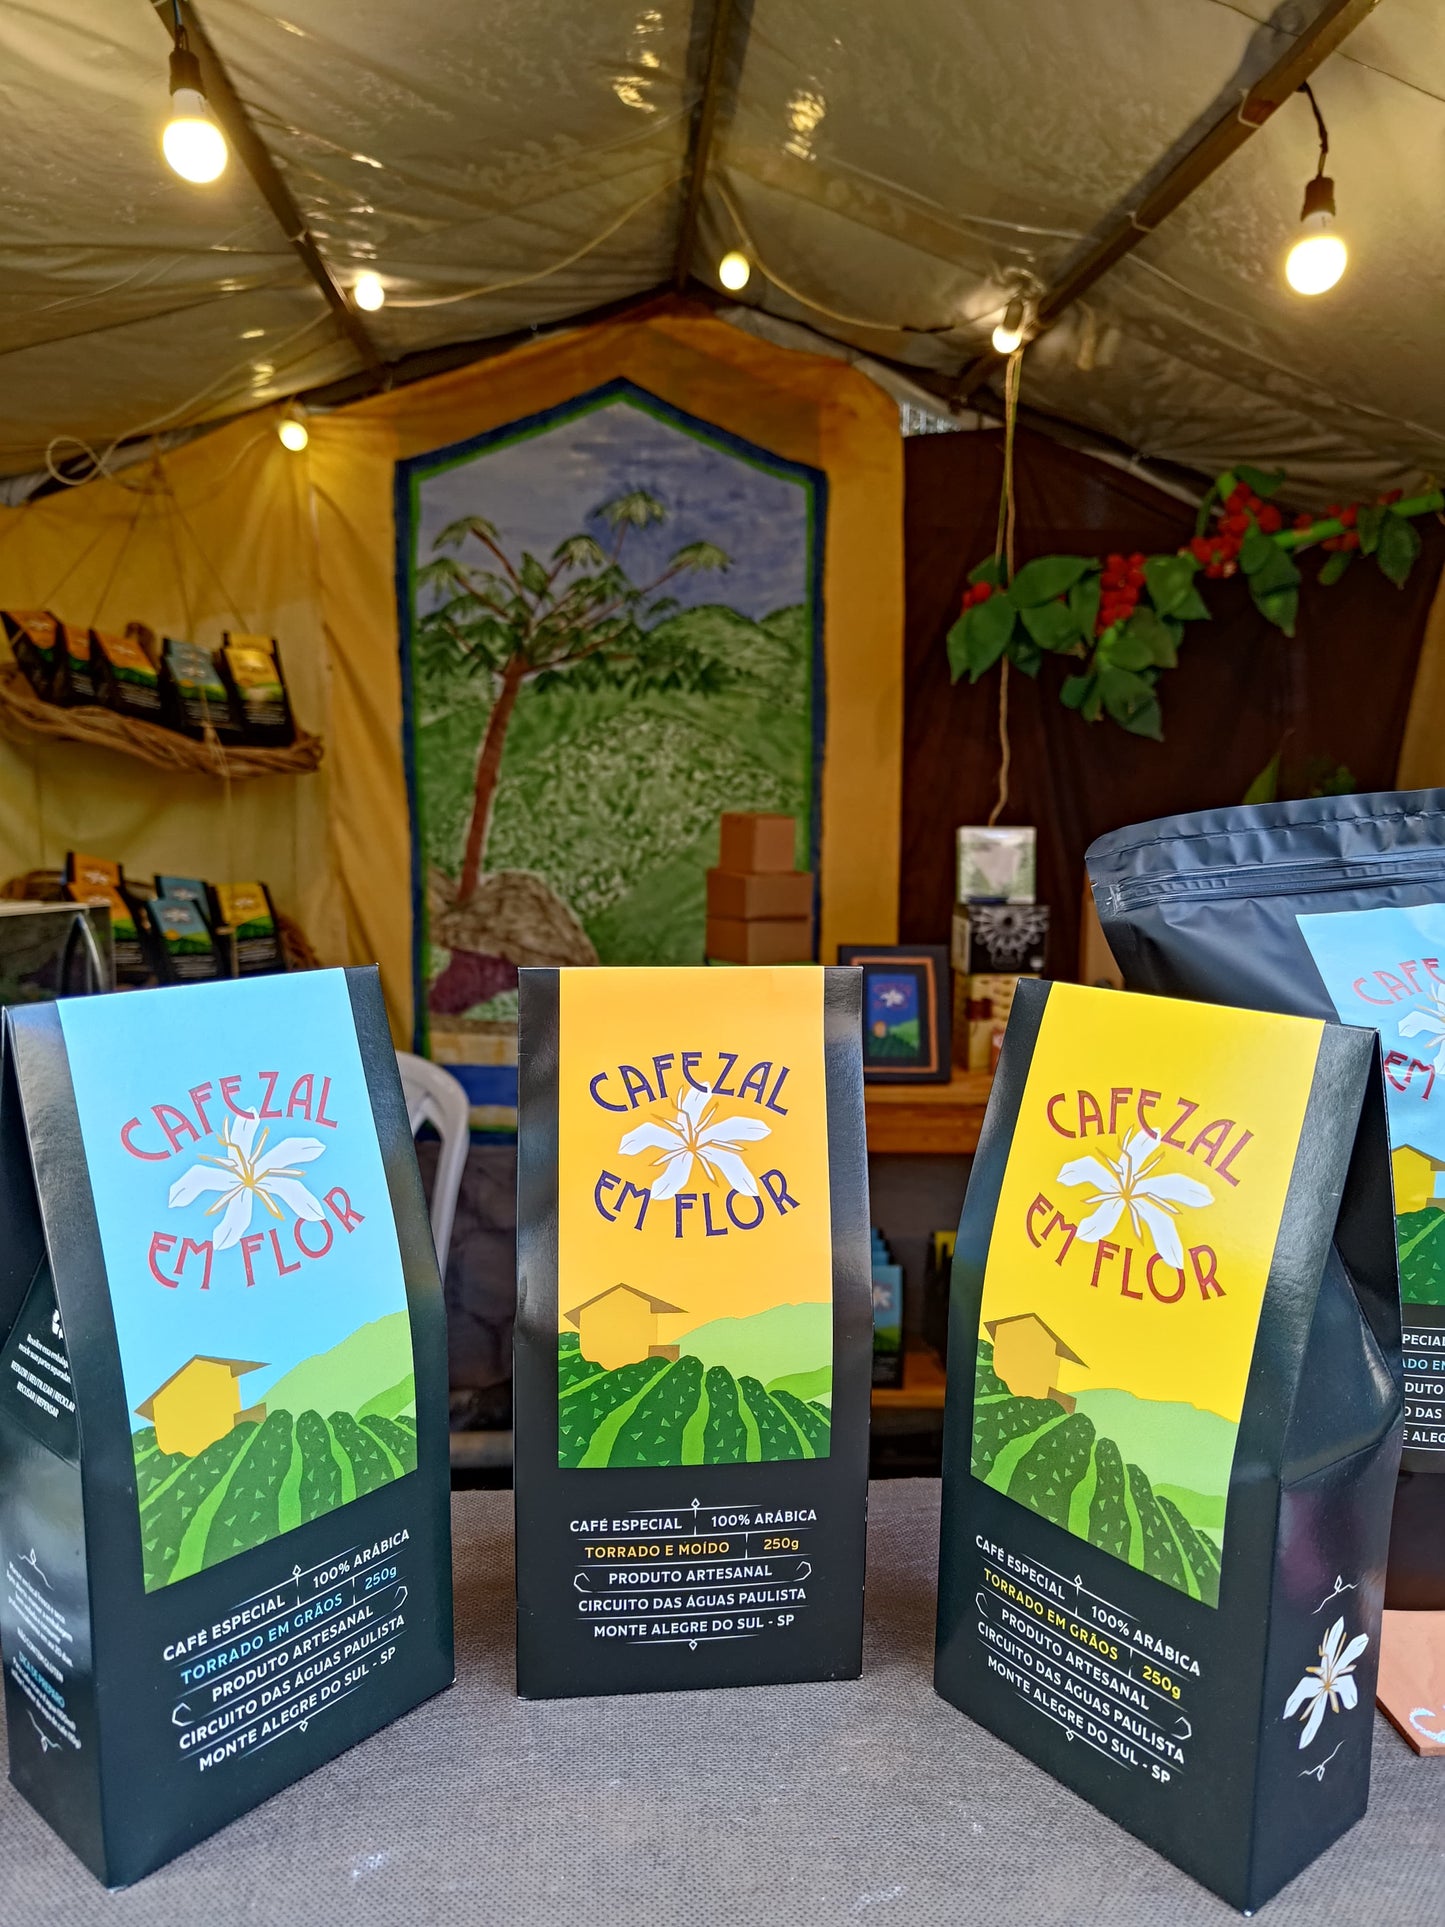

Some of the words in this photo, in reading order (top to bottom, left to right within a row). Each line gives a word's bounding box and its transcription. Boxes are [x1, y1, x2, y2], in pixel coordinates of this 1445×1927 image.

[589, 1051, 790, 1116] CAFEZAL
[1384, 1049, 1436, 1101] EM
[120, 1071, 338, 1162] CAFEZAL
[1047, 1087, 1254, 1187] CAFEZAL
[594, 1169, 651, 1231] EM
[675, 1168, 800, 1238] FLOR
[148, 1231, 213, 1290] EM
[240, 1186, 365, 1288] FLOR
[1026, 1192, 1078, 1266] EM
[1090, 1239, 1227, 1304] FLOR
[1416, 1407, 1442, 1419] DAS
[570, 1518, 608, 1532] CAFÉ
[612, 1517, 682, 1532] ESPECIAL
[585, 1545, 660, 1558] TORRADO
[665, 1544, 674, 1556] E
[679, 1540, 730, 1556] MOÍDO
[711, 1513, 750, 1528] 100%
[755, 1509, 817, 1525] ARÁBICA
[764, 1538, 800, 1551] 250g
[313, 1560, 350, 1588] 100%
[354, 1528, 410, 1568] ARÁBICA
[364, 1565, 398, 1591] 250g
[608, 1571, 682, 1585] PRODUTO
[686, 1565, 772, 1582] ARTESANAL
[975, 1534, 1005, 1562] CAFÉ
[1007, 1556, 1066, 1601] ESPECIAL
[163, 1629, 208, 1661] CAFÉ
[212, 1595, 286, 1640] ESPECIAL
[578, 1598, 649, 1612] CIRCUITO
[653, 1596, 682, 1610] DAS
[686, 1592, 735, 1608] ÁGUAS
[739, 1588, 806, 1605] PAULISTA
[594, 1624, 647, 1638] MONTE
[651, 1620, 708, 1636] ALEGRE
[712, 1619, 734, 1632] DO
[737, 1616, 764, 1630] SUL
[777, 1614, 795, 1626] SP
[983, 1568, 1044, 1616] TORRADO
[1047, 1610, 1066, 1630] EM
[1070, 1624, 1118, 1661] GRÃOS
[180, 1635, 264, 1684] TORRADO
[268, 1622, 290, 1642] EM
[294, 1593, 343, 1628] GRÃOS
[212, 1652, 289, 1702] PRODUTO
[292, 1605, 374, 1659] ARTESANAL
[1001, 1608, 1062, 1656] PRODUTO
[1066, 1651, 1150, 1710] ARTESANAL
[1092, 1605, 1130, 1637] 100%
[1133, 1629, 1201, 1677] ARÁBICA
[179, 1699, 258, 1750] CIRCUITO
[262, 1680, 291, 1705] DAS
[295, 1650, 342, 1686] ÁGUAS
[344, 1614, 405, 1660] PAULISTA
[199, 1733, 258, 1772] MONTE
[261, 1695, 318, 1737] ALEGRE
[321, 1679, 342, 1700] DO
[344, 1664, 370, 1686] SUL
[380, 1646, 396, 1666] SP
[978, 1621, 1033, 1667] CIRCUITO
[1036, 1660, 1062, 1686] DAS
[1064, 1679, 1110, 1716] ÁGUAS
[1114, 1710, 1185, 1764] PAULISTA
[1142, 1666, 1182, 1700] 250g
[988, 1655, 1030, 1694] MONTE
[1034, 1688, 1084, 1730] ALEGRE
[1087, 1724, 1108, 1744] DO
[1111, 1740, 1138, 1766] SUL
[1152, 1764, 1171, 1784] SP
